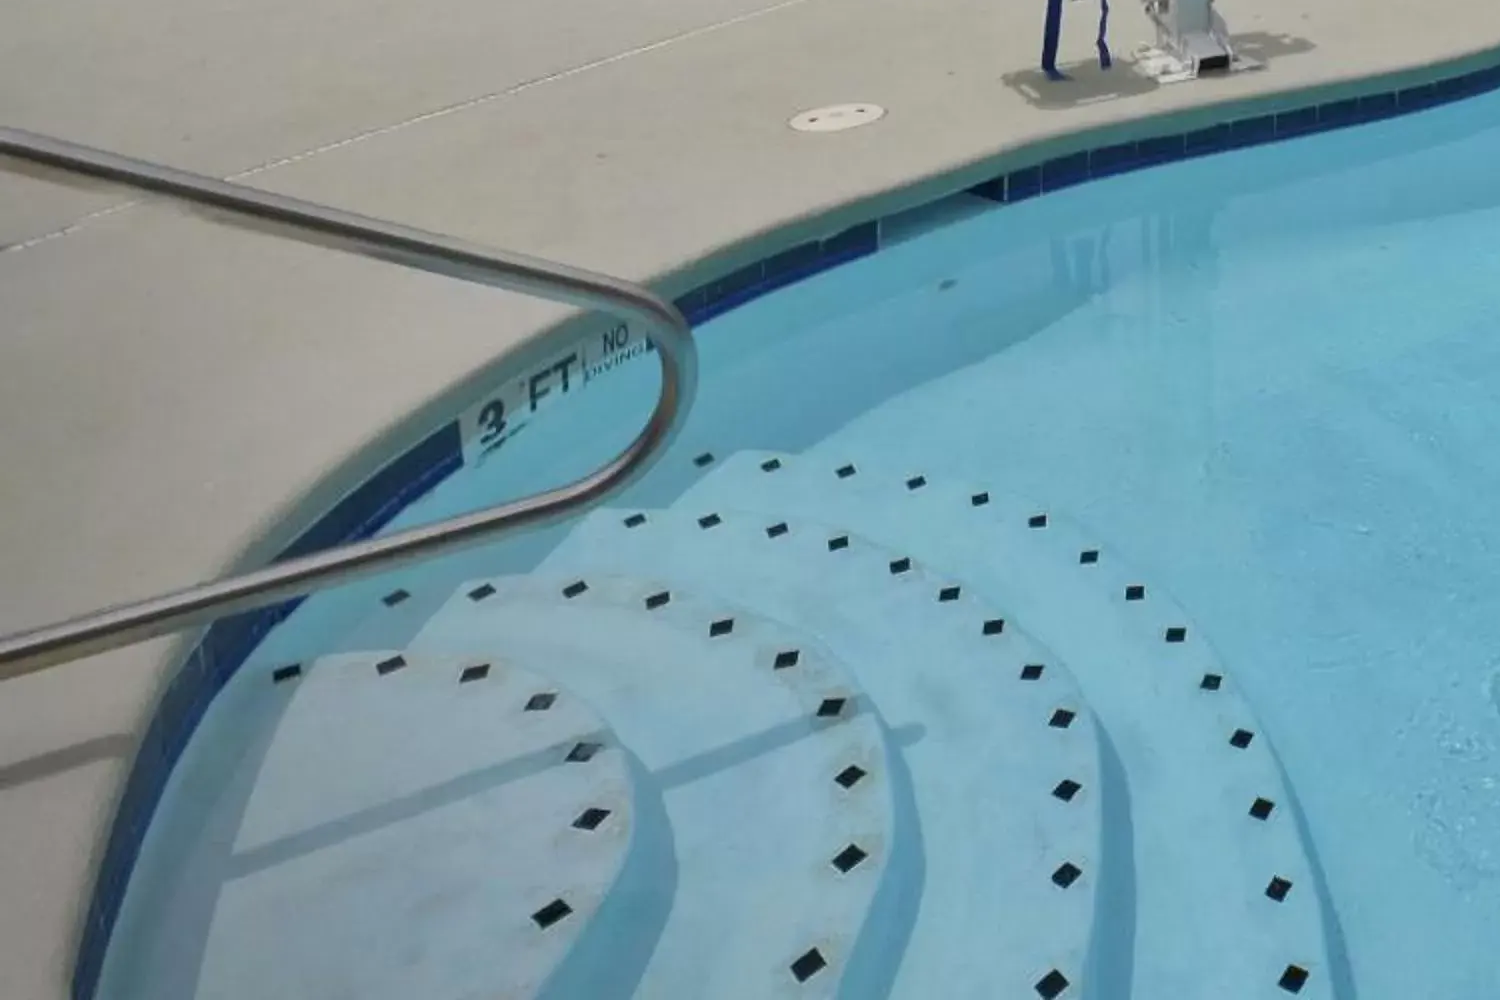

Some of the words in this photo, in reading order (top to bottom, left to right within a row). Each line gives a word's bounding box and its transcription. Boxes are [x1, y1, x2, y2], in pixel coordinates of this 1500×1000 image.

[602, 322, 629, 354] NO
[478, 399, 507, 444] 3
[529, 352, 577, 413] FT
